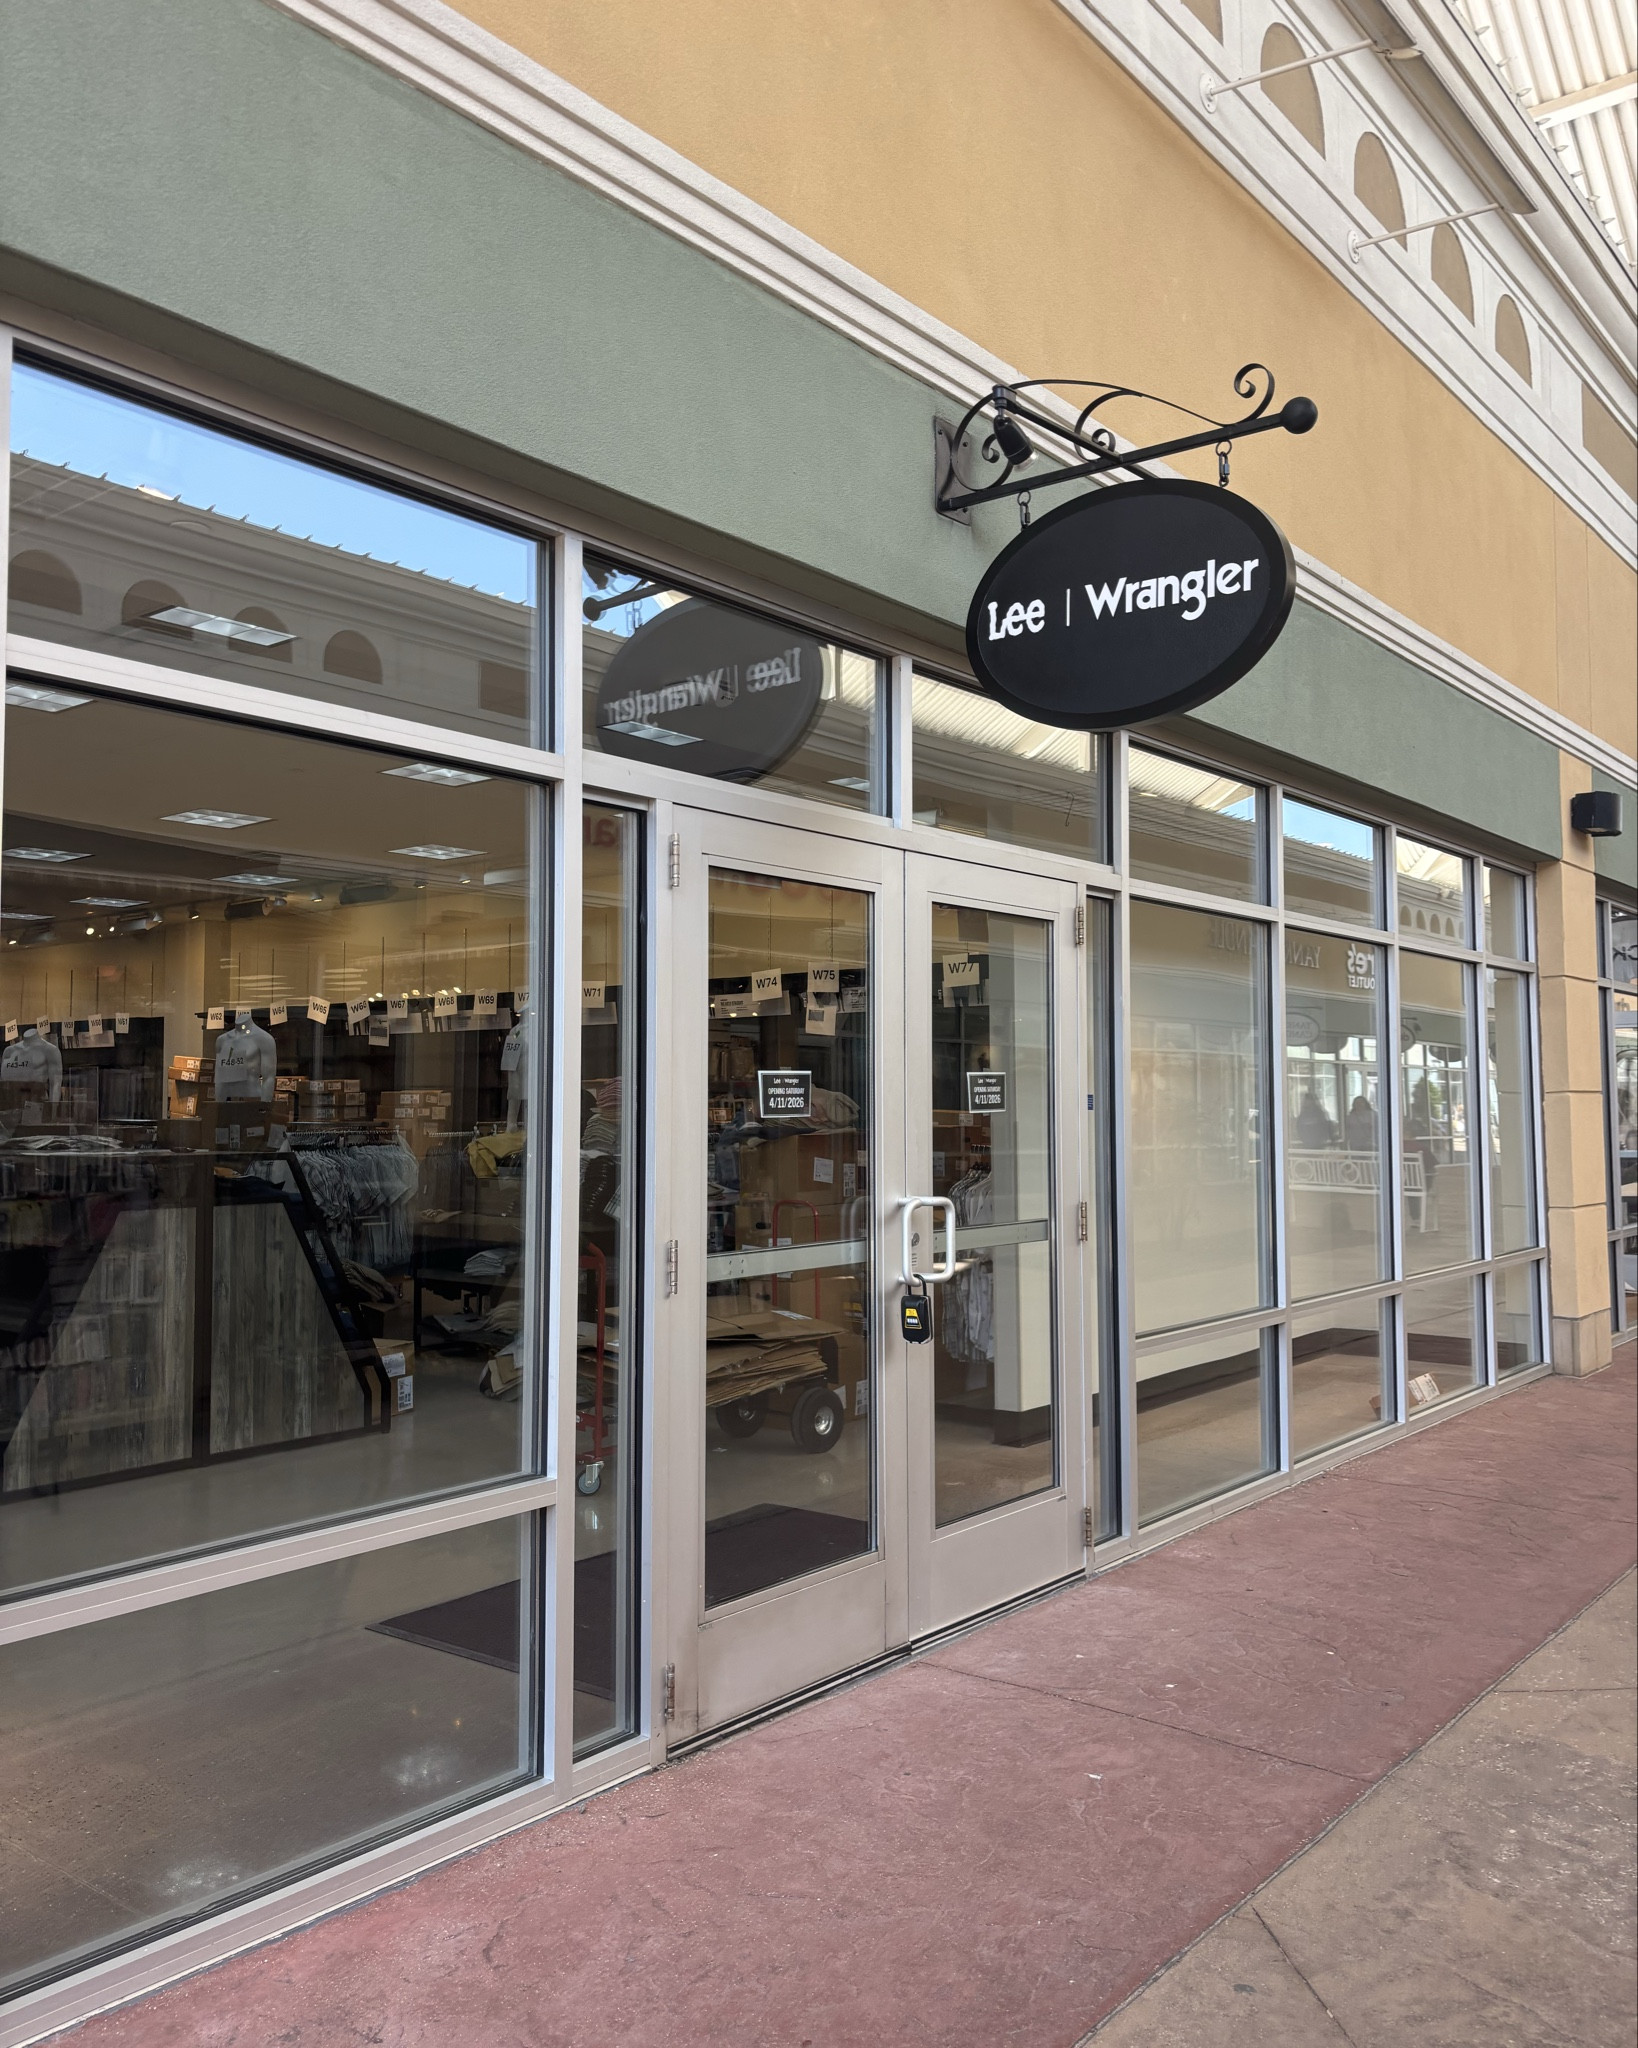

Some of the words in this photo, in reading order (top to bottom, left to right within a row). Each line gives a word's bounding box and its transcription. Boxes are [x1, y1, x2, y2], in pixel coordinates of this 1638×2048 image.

[988, 599, 1045, 641] Lee
[1084, 559, 1259, 621] Wrangler
[948, 962, 974, 974] W77
[812, 969, 836, 981] W75
[756, 977, 778, 989] W74
[518, 992, 530, 1002] W7
[583, 987, 602, 998] W71
[390, 1000, 406, 1009] W67
[438, 996, 455, 1007] W68
[478, 995, 495, 1005] W69
[272, 1005, 285, 1016] W64
[312, 1002, 327, 1015] W65
[210, 1012, 223, 1021] W62
[768, 1087, 786, 1095] OPENING
[786, 1087, 806, 1095] SATURDAY
[769, 1096, 805, 1109] 4/11/2026
[974, 1094, 1002, 1105] 4/11/2026
